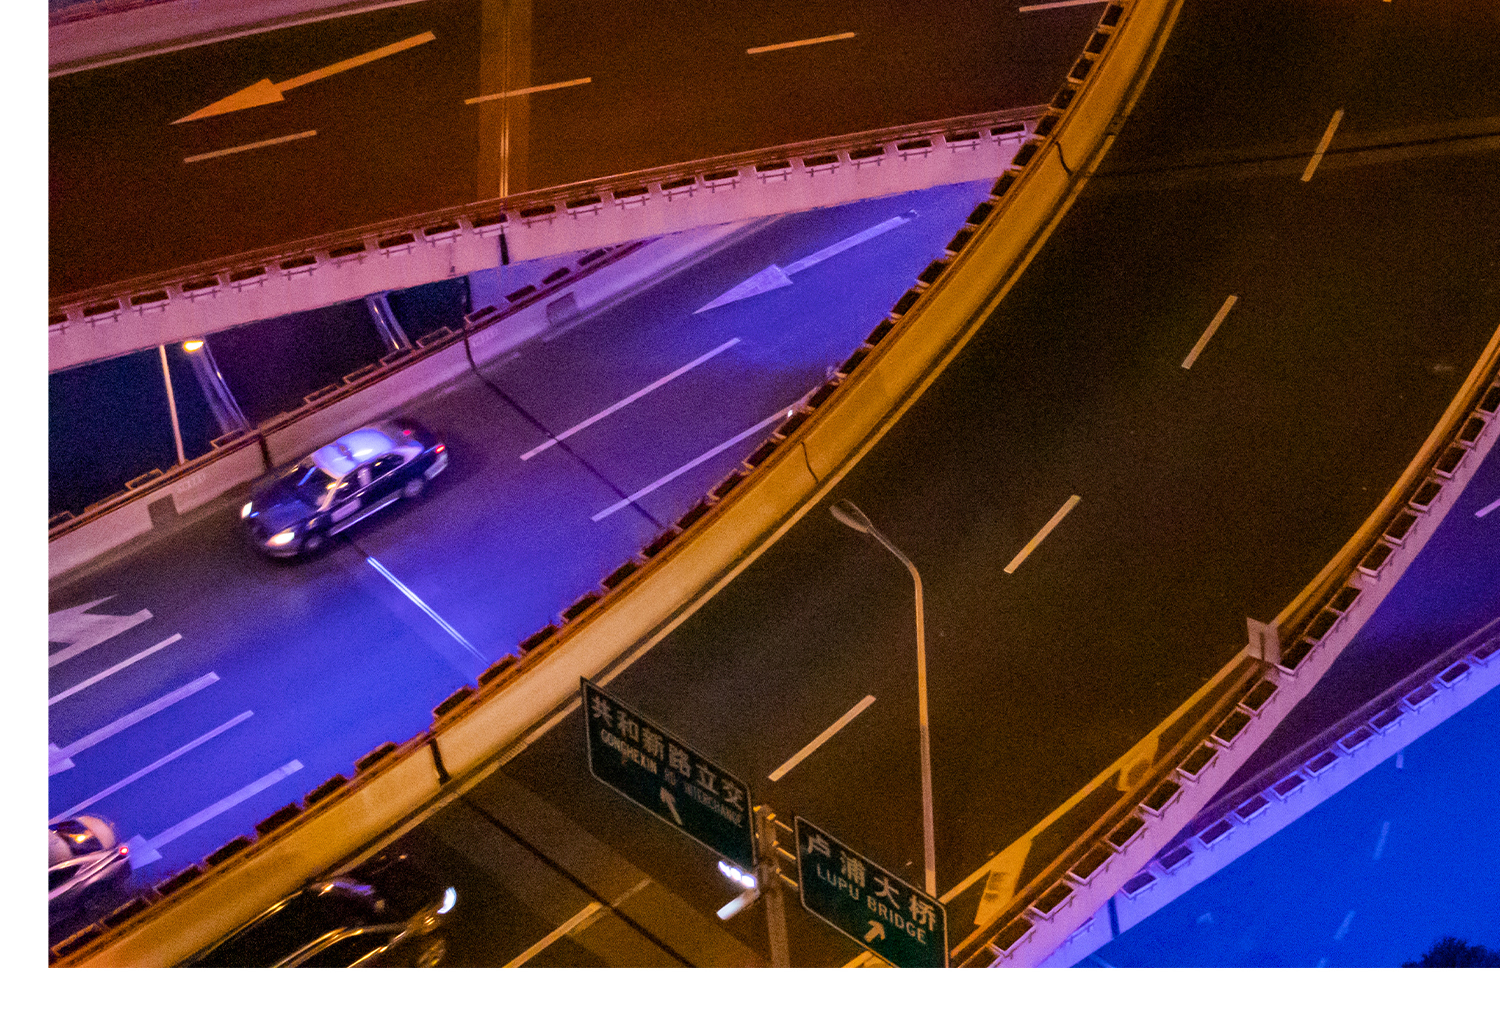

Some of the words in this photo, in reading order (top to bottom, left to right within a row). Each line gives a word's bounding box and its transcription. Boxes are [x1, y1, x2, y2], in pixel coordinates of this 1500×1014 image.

[591, 695, 744, 813] 共和新路立交
[807, 834, 936, 931] 卢浦大桥
[816, 863, 859, 901] LUPU
[867, 895, 926, 945] BRIDGE
